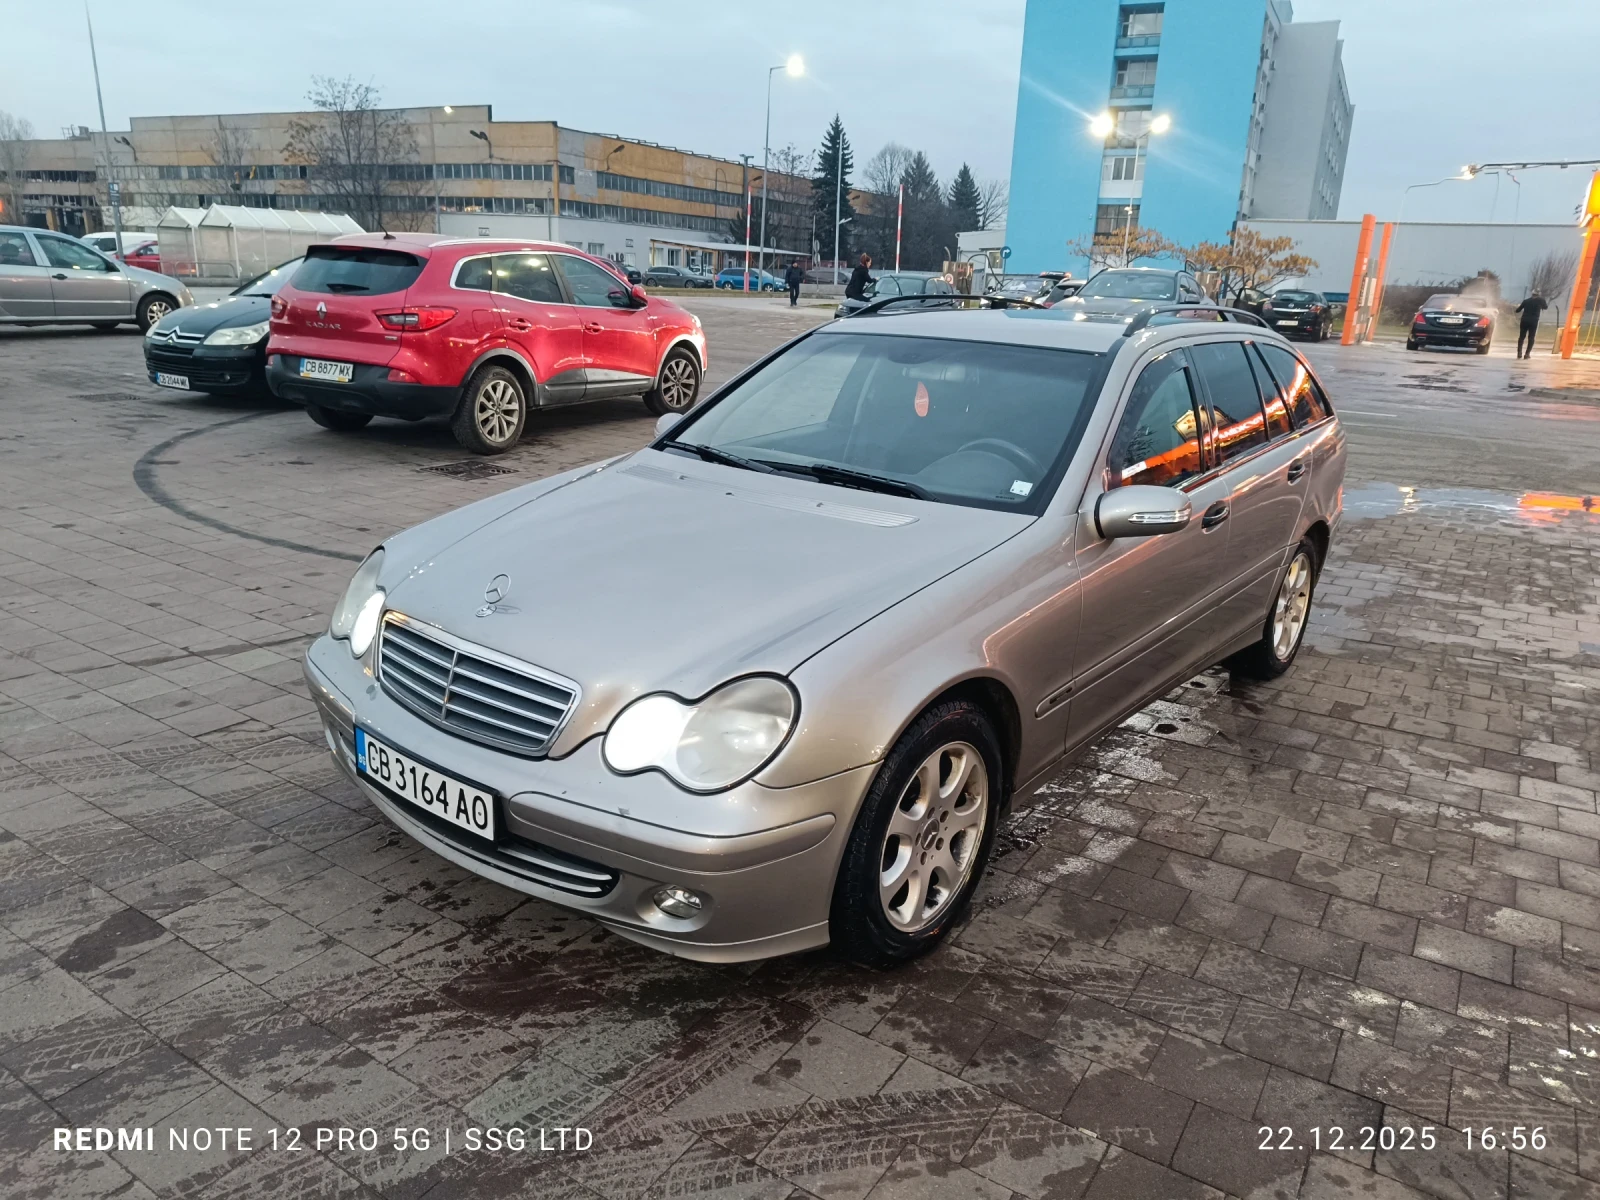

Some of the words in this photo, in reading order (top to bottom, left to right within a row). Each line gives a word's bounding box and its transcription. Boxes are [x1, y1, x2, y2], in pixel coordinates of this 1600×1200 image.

[305, 321, 342, 330] KADJAR
[305, 361, 317, 372] CB
[318, 363, 338, 375] 8877
[339, 364, 351, 377] MX
[358, 753, 366, 766] BG
[367, 741, 391, 782] CB
[395, 757, 449, 815] 3164
[455, 787, 488, 830] AO
